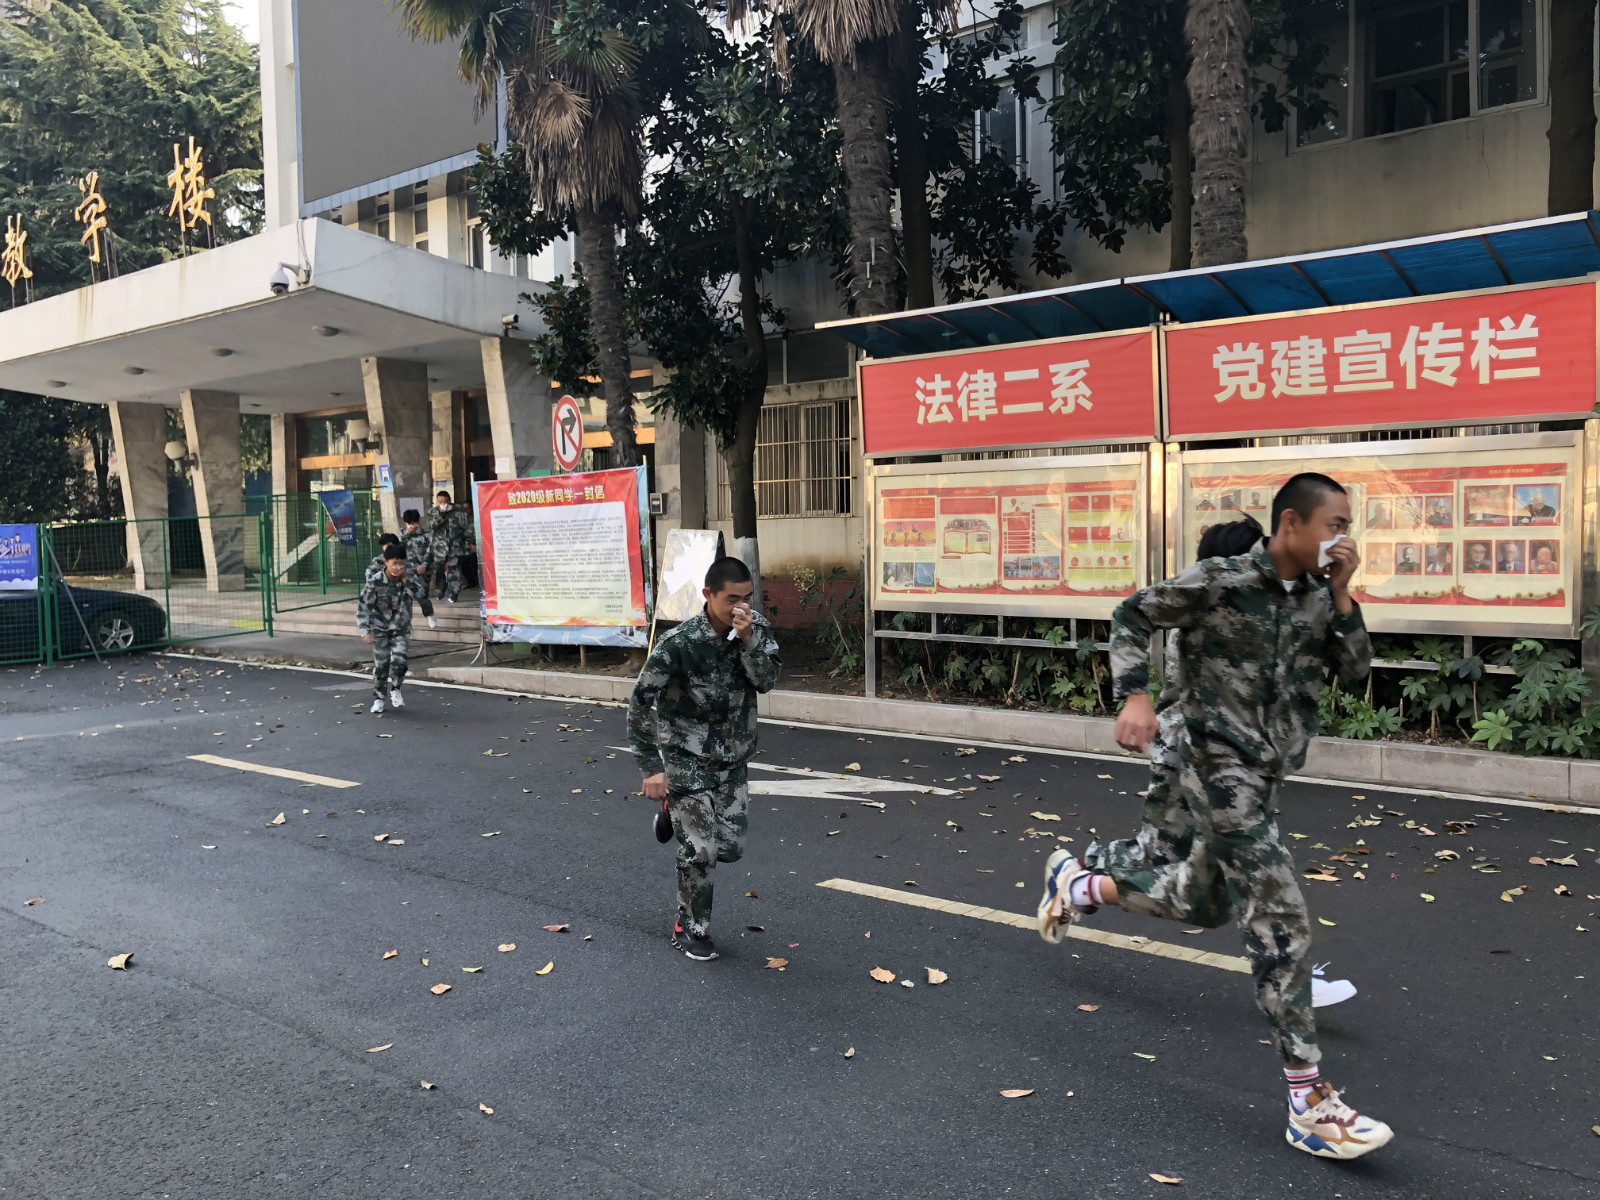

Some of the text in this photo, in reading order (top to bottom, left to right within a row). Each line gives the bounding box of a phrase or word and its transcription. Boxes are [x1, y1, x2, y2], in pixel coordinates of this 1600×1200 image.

[1, 136, 215, 288] 教学楼
[914, 359, 1093, 425] 法律二系
[1212, 313, 1541, 404] 党建宣传栏
[507, 484, 605, 506] 致2020级新同学一封信
